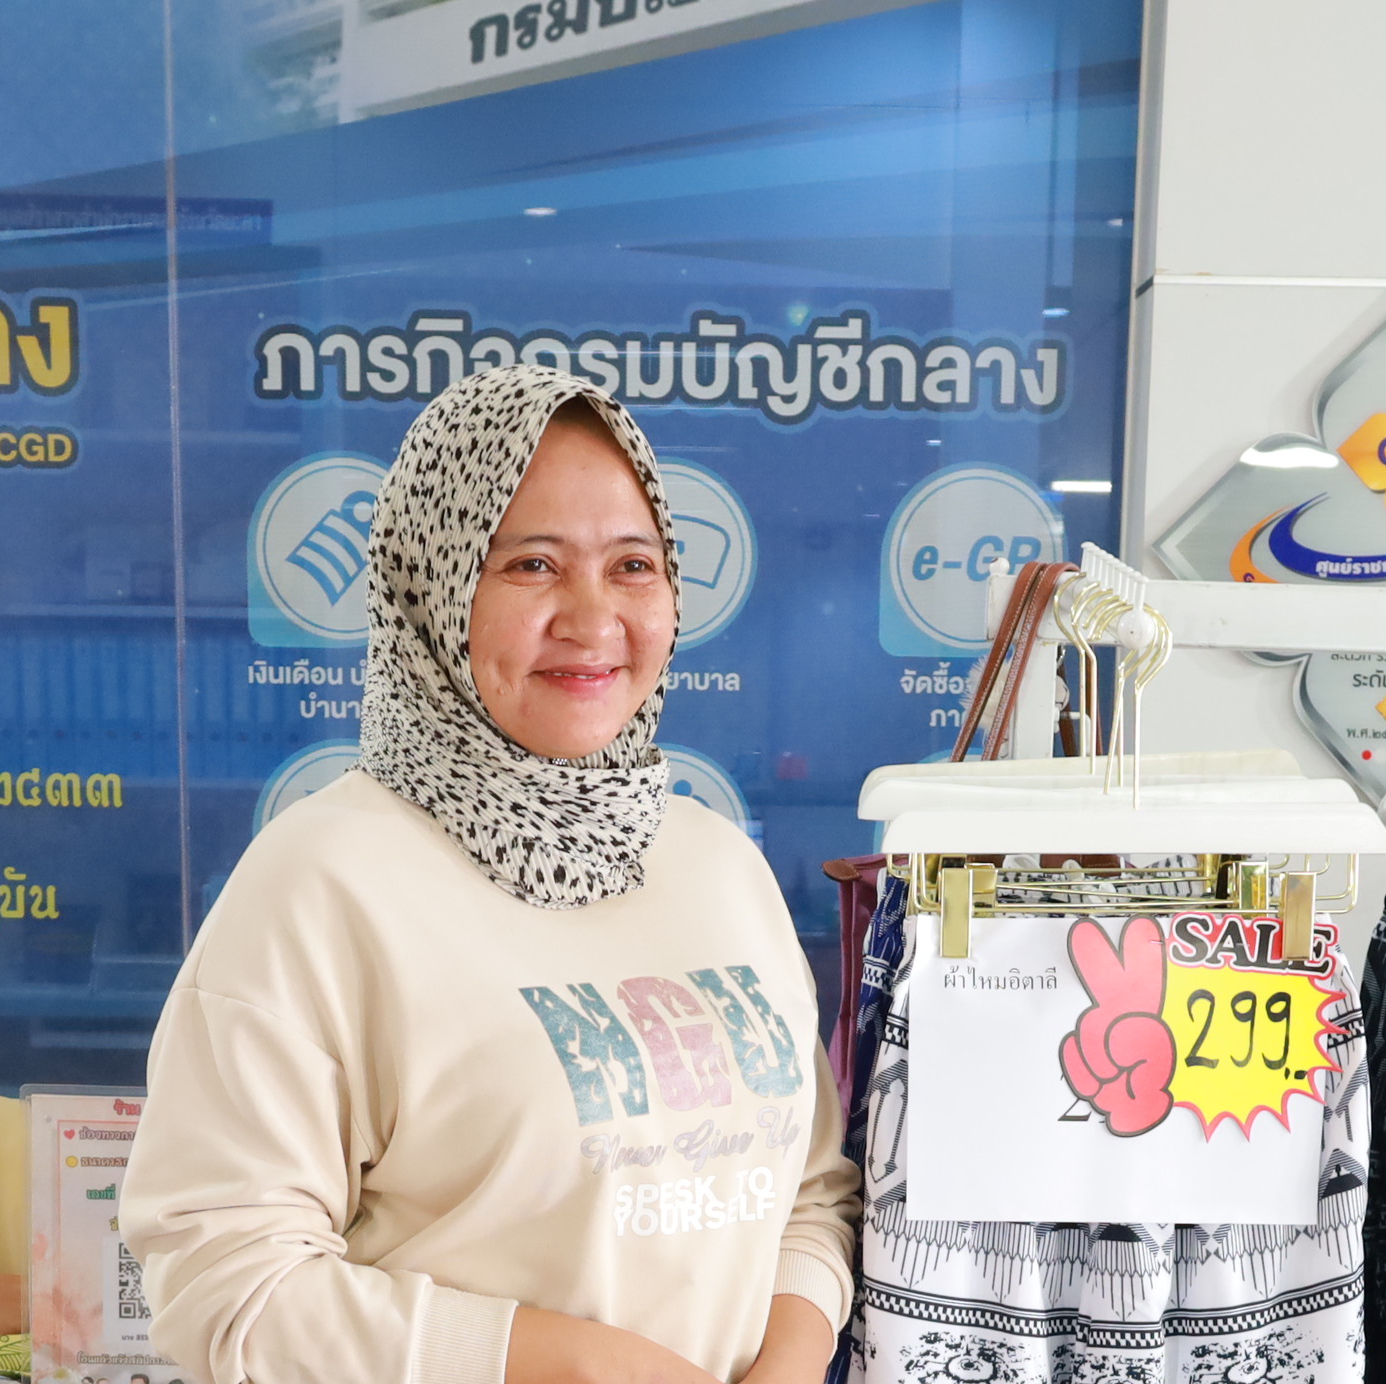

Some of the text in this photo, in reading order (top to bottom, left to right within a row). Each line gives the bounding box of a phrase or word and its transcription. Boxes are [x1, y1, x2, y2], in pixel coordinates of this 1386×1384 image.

[262, 317, 1059, 417] ภารกิจกรมบัญชีกลาง
[912, 535, 1043, 582] e-GP
[248, 659, 344, 685] เงินเดือน
[666, 671, 741, 691] ยาบาล
[900, 662, 971, 694] จัดซื้อ
[300, 692, 362, 719] บำนา
[1171, 917, 1332, 974] SALE
[944, 964, 1058, 990] ผ้าไหมอิตาลี
[518, 965, 803, 1127] NGU
[78, 1126, 136, 1141] ช่องทางกา
[613, 1193, 776, 1237] YOURSELF
